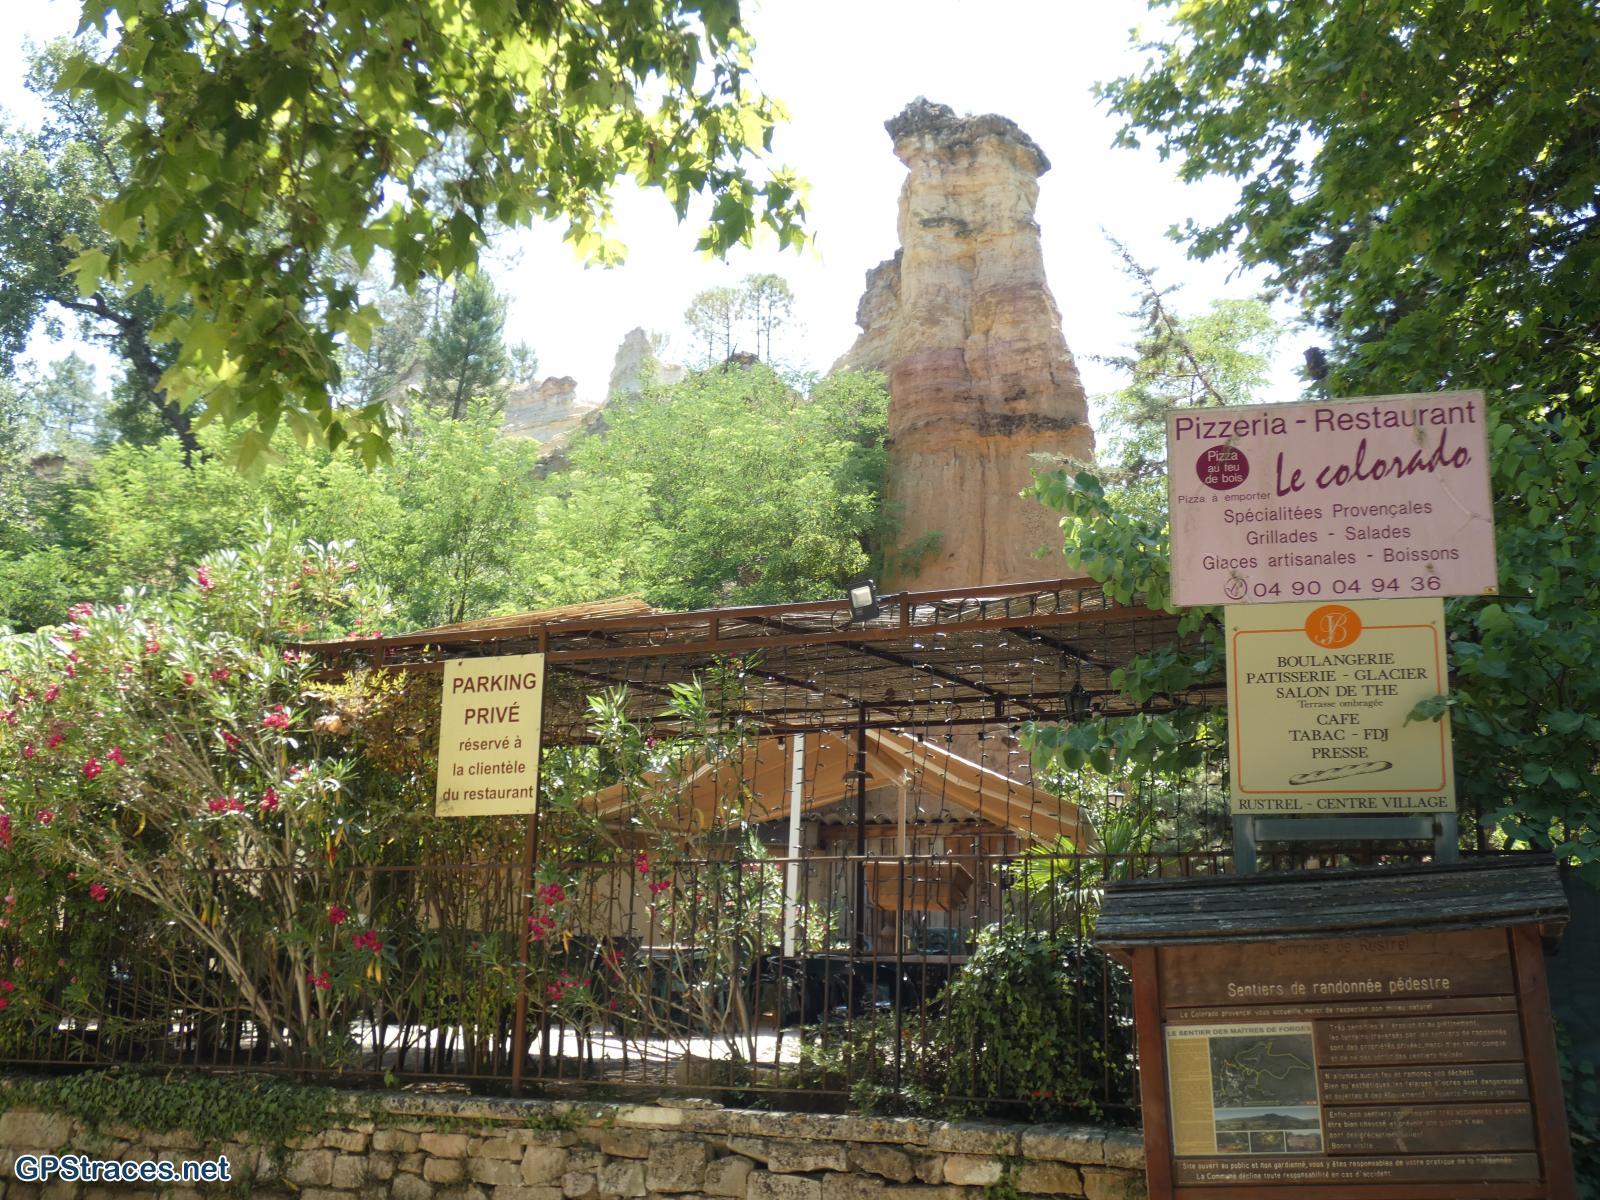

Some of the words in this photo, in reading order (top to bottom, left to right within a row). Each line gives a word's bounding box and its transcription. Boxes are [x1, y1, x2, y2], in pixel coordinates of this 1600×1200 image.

[1176, 412, 1287, 441] Pizzeria
[1315, 401, 1476, 433] Restaurant
[1207, 450, 1238, 462] Pizza
[1316, 428, 1472, 490] colorado
[1207, 464, 1220, 473] au
[1224, 463, 1240, 472] feu
[1204, 475, 1218, 484] de
[1221, 473, 1244, 483] bois
[1178, 495, 1205, 504] Pizza
[1212, 494, 1218, 502] à
[1224, 492, 1271, 502] emporter
[1224, 505, 1322, 526] Spécialitées
[1333, 501, 1432, 521] Provençales
[1246, 530, 1318, 546] Grillades
[1345, 526, 1411, 541] Salades
[1203, 555, 1257, 571] Glaces
[1268, 551, 1356, 567] artisanales
[1383, 547, 1459, 563] Boissons
[1253, 581, 1281, 597] 04
[1291, 580, 1321, 596] 90
[1332, 579, 1361, 594] 04
[1372, 577, 1400, 593] 94
[1410, 576, 1441, 591] 36
[1277, 653, 1395, 668] BOULANGERIE
[453, 672, 536, 694] PARKING
[1246, 671, 1336, 684] PATISSERIE
[1354, 668, 1428, 681] GLACIER
[1276, 686, 1329, 699] SALON
[1336, 685, 1357, 697] DE
[1361, 684, 1398, 696] THE
[1298, 699, 1336, 709] Terrasse
[1339, 698, 1383, 709] ombragée
[465, 702, 520, 725] PRIVÉ
[1316, 713, 1360, 726] CAFE
[459, 735, 509, 751] réservé
[514, 735, 522, 749] à
[1289, 729, 1346, 742] TABAC
[1364, 728, 1389, 743] FDJ
[1312, 747, 1368, 760] PRESSE
[453, 762, 464, 776] la
[468, 760, 526, 775] clientèle
[442, 788, 459, 801] du
[464, 785, 534, 801] restaurant
[1239, 799, 1303, 811] RUSTREL
[1317, 798, 1377, 810] CENTRE
[1382, 796, 1448, 808] VILLAGE
[1227, 982, 1285, 997] Sentiers
[1291, 981, 1306, 995] de
[1313, 979, 1382, 994] randonnée
[1389, 976, 1450, 995] pédestre
[1179, 1029, 1210, 1037] SENTIER
[1213, 1028, 1228, 1036] DES
[1231, 1161, 1249, 1170] public
